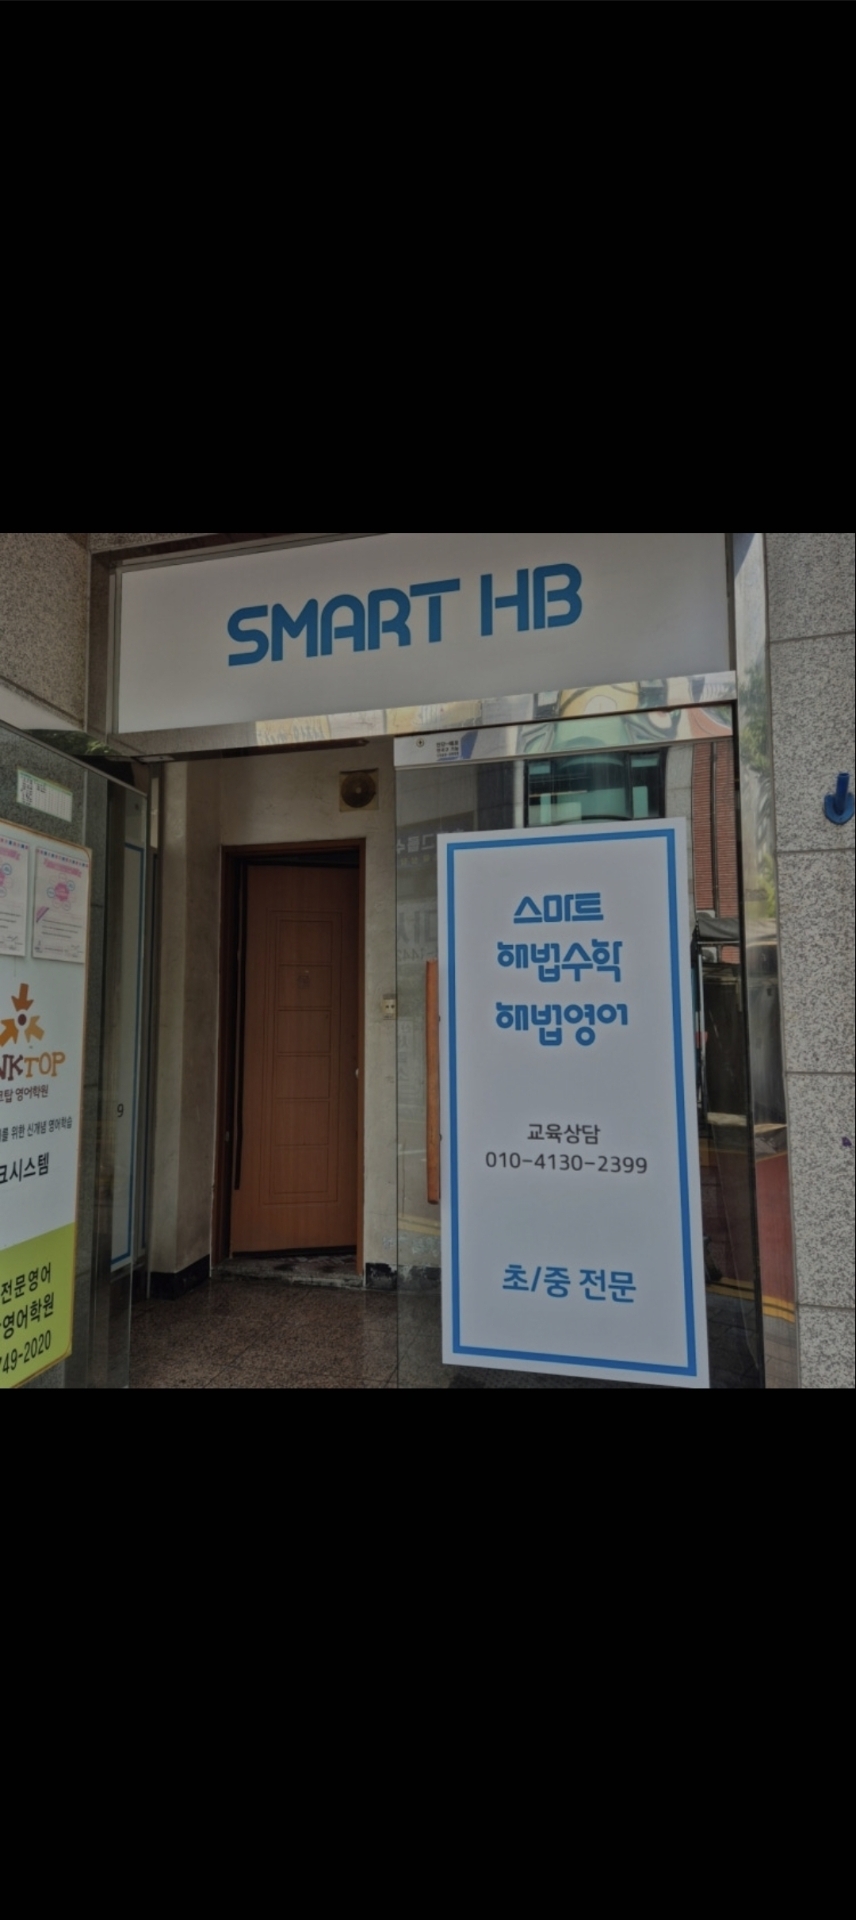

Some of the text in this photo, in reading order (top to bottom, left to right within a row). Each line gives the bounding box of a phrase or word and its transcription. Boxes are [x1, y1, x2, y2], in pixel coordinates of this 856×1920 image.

[227, 562, 583, 667] SMART HB
[513, 891, 604, 925] 스마트
[496, 938, 623, 983] 해법수학
[495, 1001, 629, 1047] 해법영어
[15, 1084, 49, 1103] 영어학원
[0, 1126, 9, 1144] 를
[11, 1124, 25, 1141] 위한
[27, 1120, 47, 1138] 신개념
[527, 1123, 601, 1145] 교육상담
[485, 1151, 648, 1174] 010-4130-2399
[502, 1263, 637, 1304] 초/중 전문
[0, 1291, 55, 1340] 영어학원
